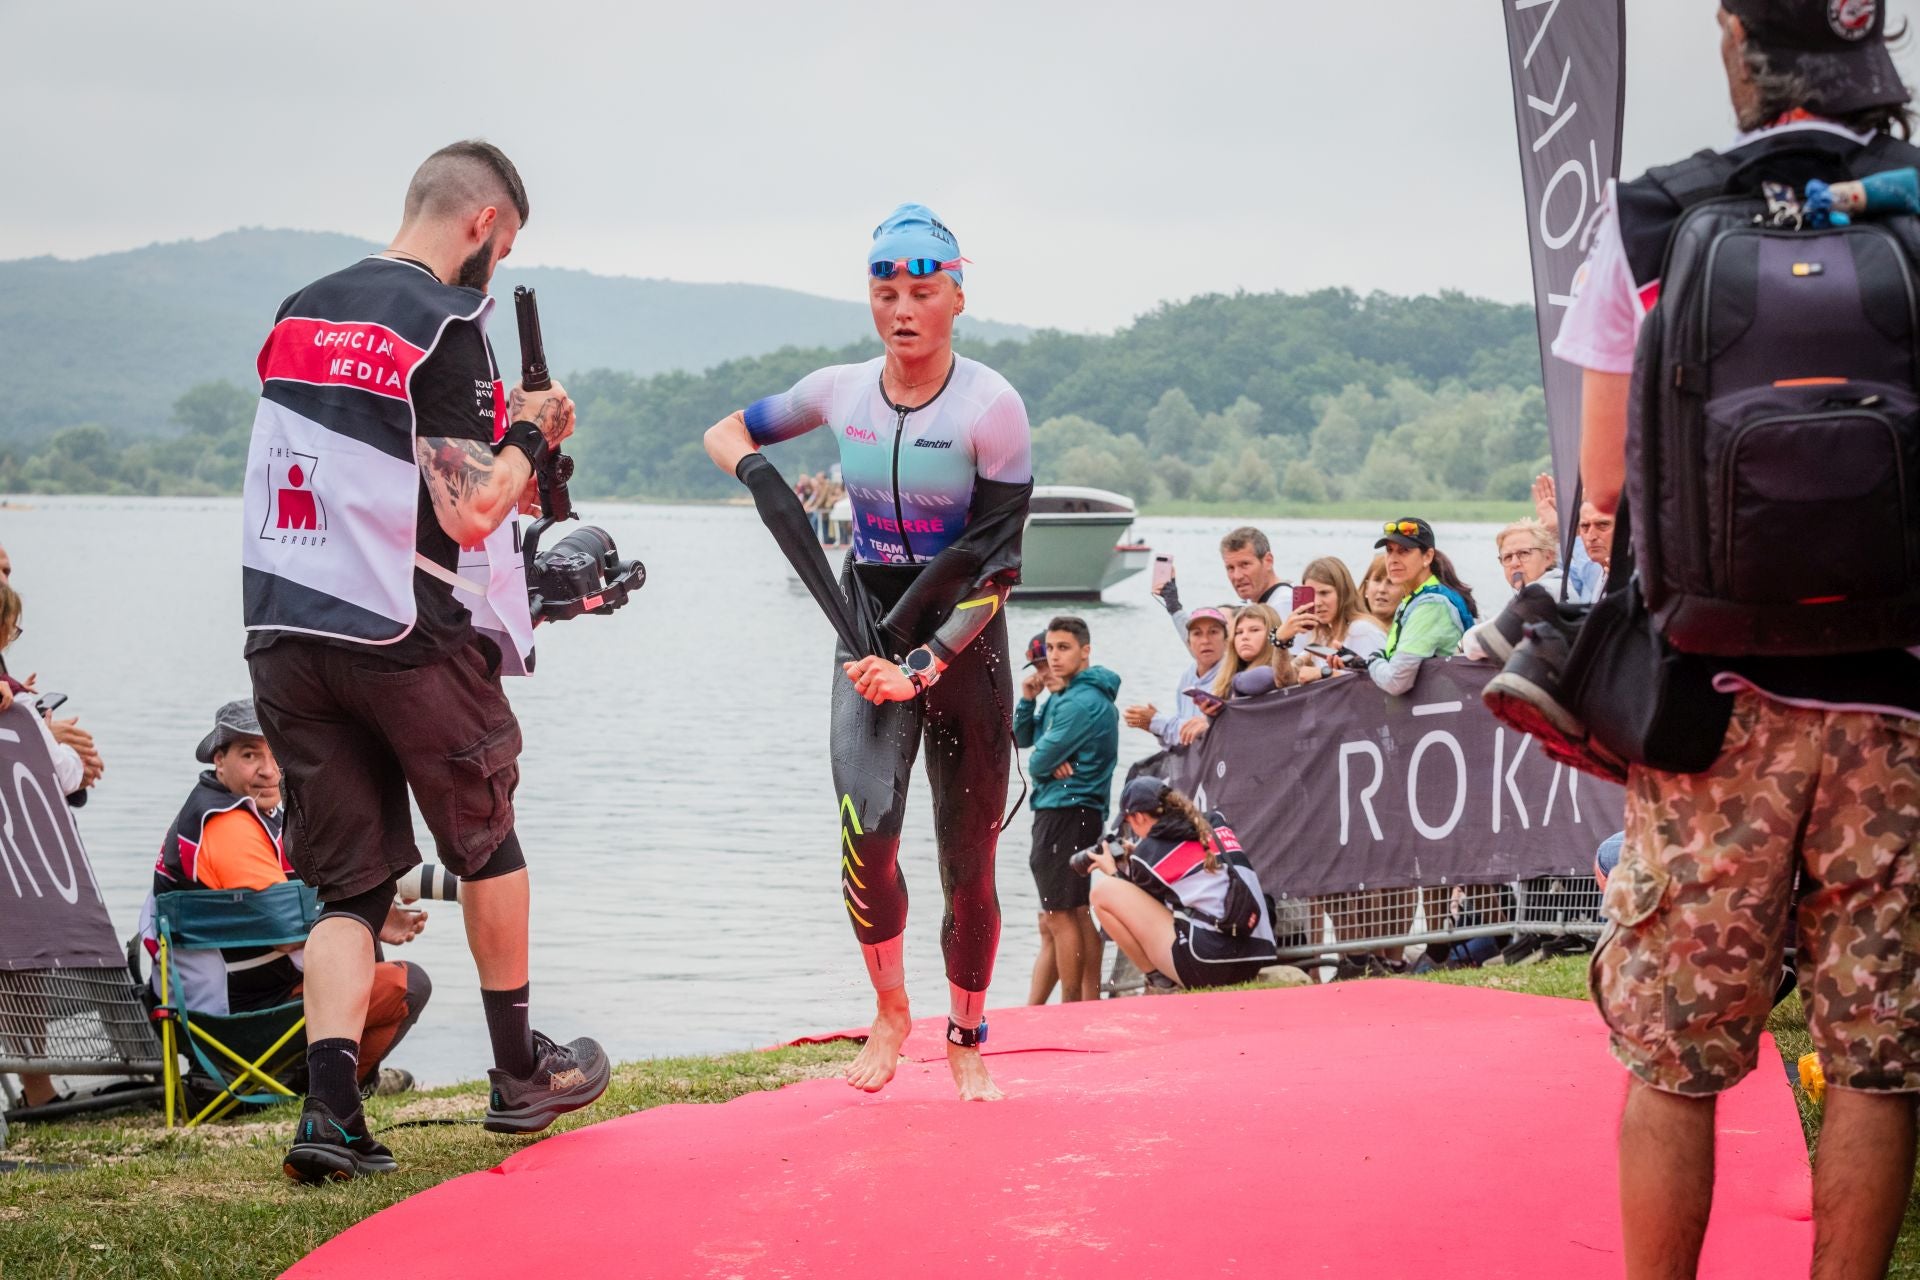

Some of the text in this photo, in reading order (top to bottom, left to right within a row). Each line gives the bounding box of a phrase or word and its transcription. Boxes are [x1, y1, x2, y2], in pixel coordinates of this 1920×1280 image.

[329, 358, 402, 390] MEDIA
[914, 438, 953, 449] Santini
[268, 447, 291, 458] THE
[281, 534, 327, 547] GROUP
[869, 538, 904, 554] TEAM
